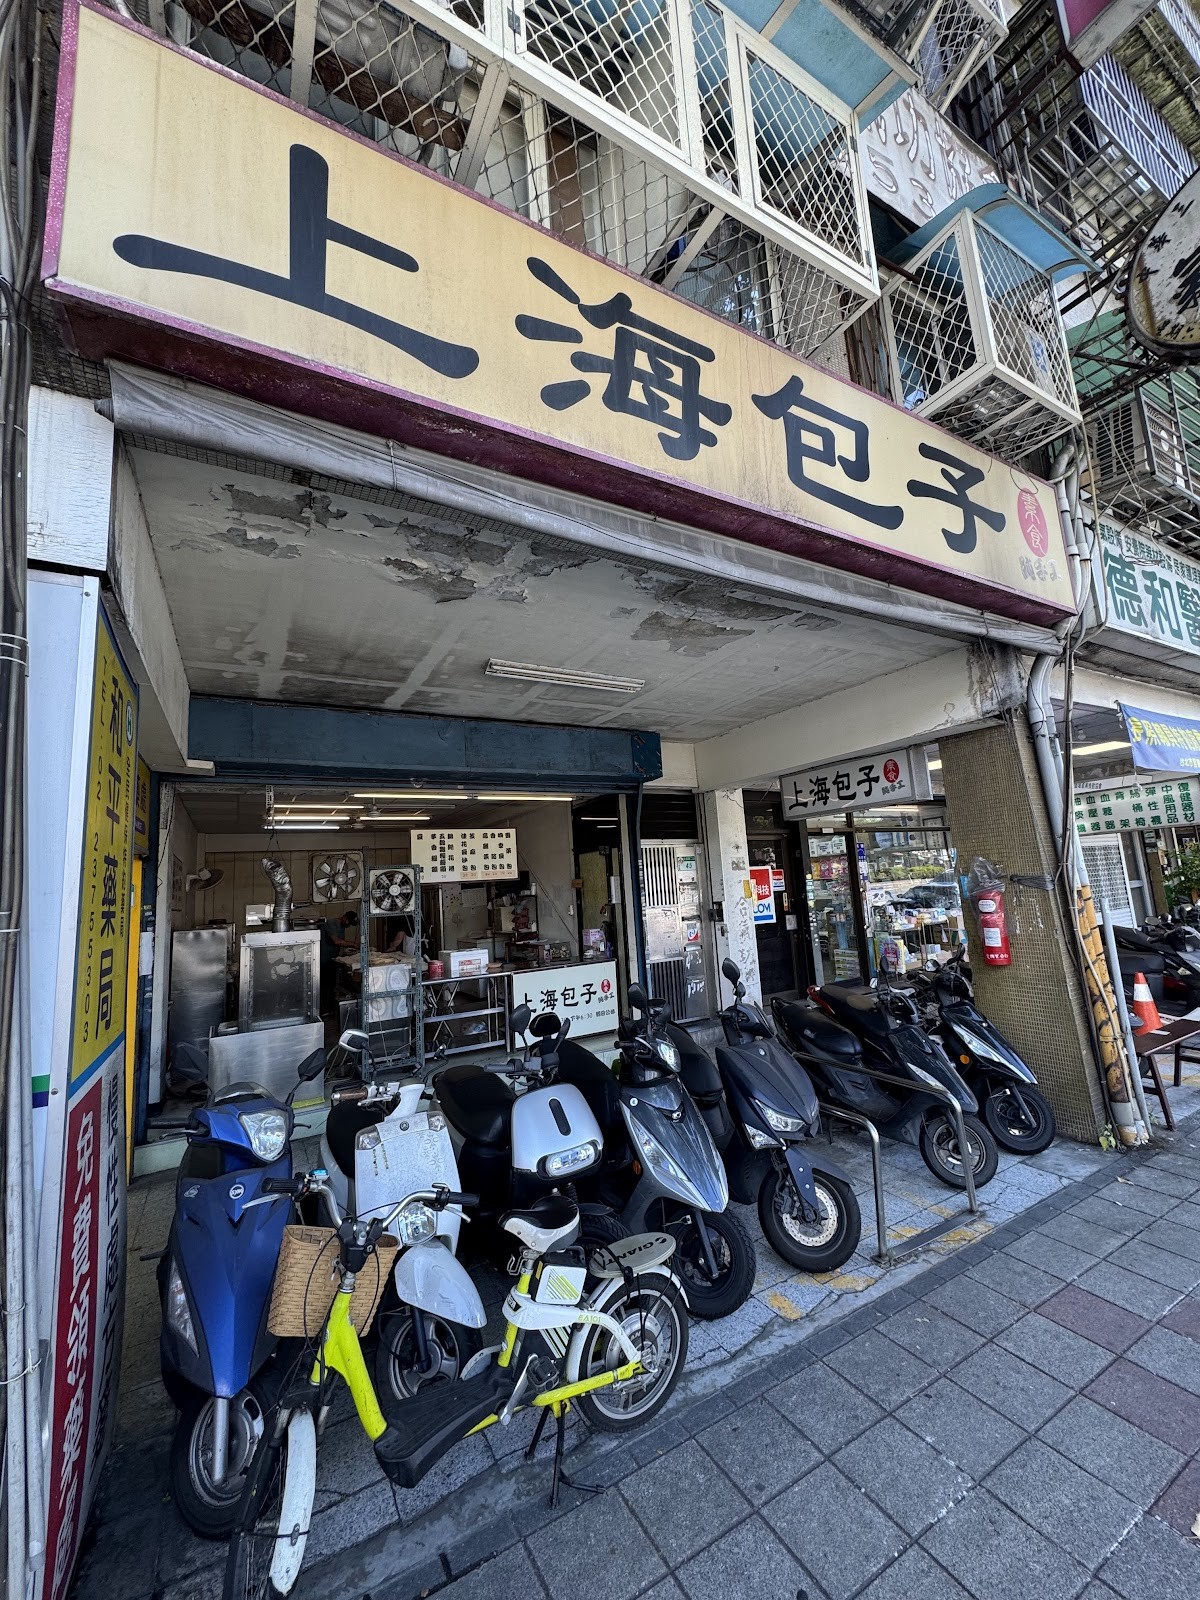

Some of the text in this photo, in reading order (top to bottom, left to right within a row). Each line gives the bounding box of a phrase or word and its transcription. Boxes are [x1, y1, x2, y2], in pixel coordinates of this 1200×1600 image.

[113, 143, 1006, 553] 上海包子
[1021, 491, 1047, 556] 素食
[788, 764, 880, 811] 上海包子
[1161, 784, 1179, 824] 中風用品
[1177, 782, 1195, 823] 復健器材
[95, 675, 124, 1040] 和平藥局
[524, 983, 597, 1013] 上海包子
[606, 1241, 654, 1265] GIANT
